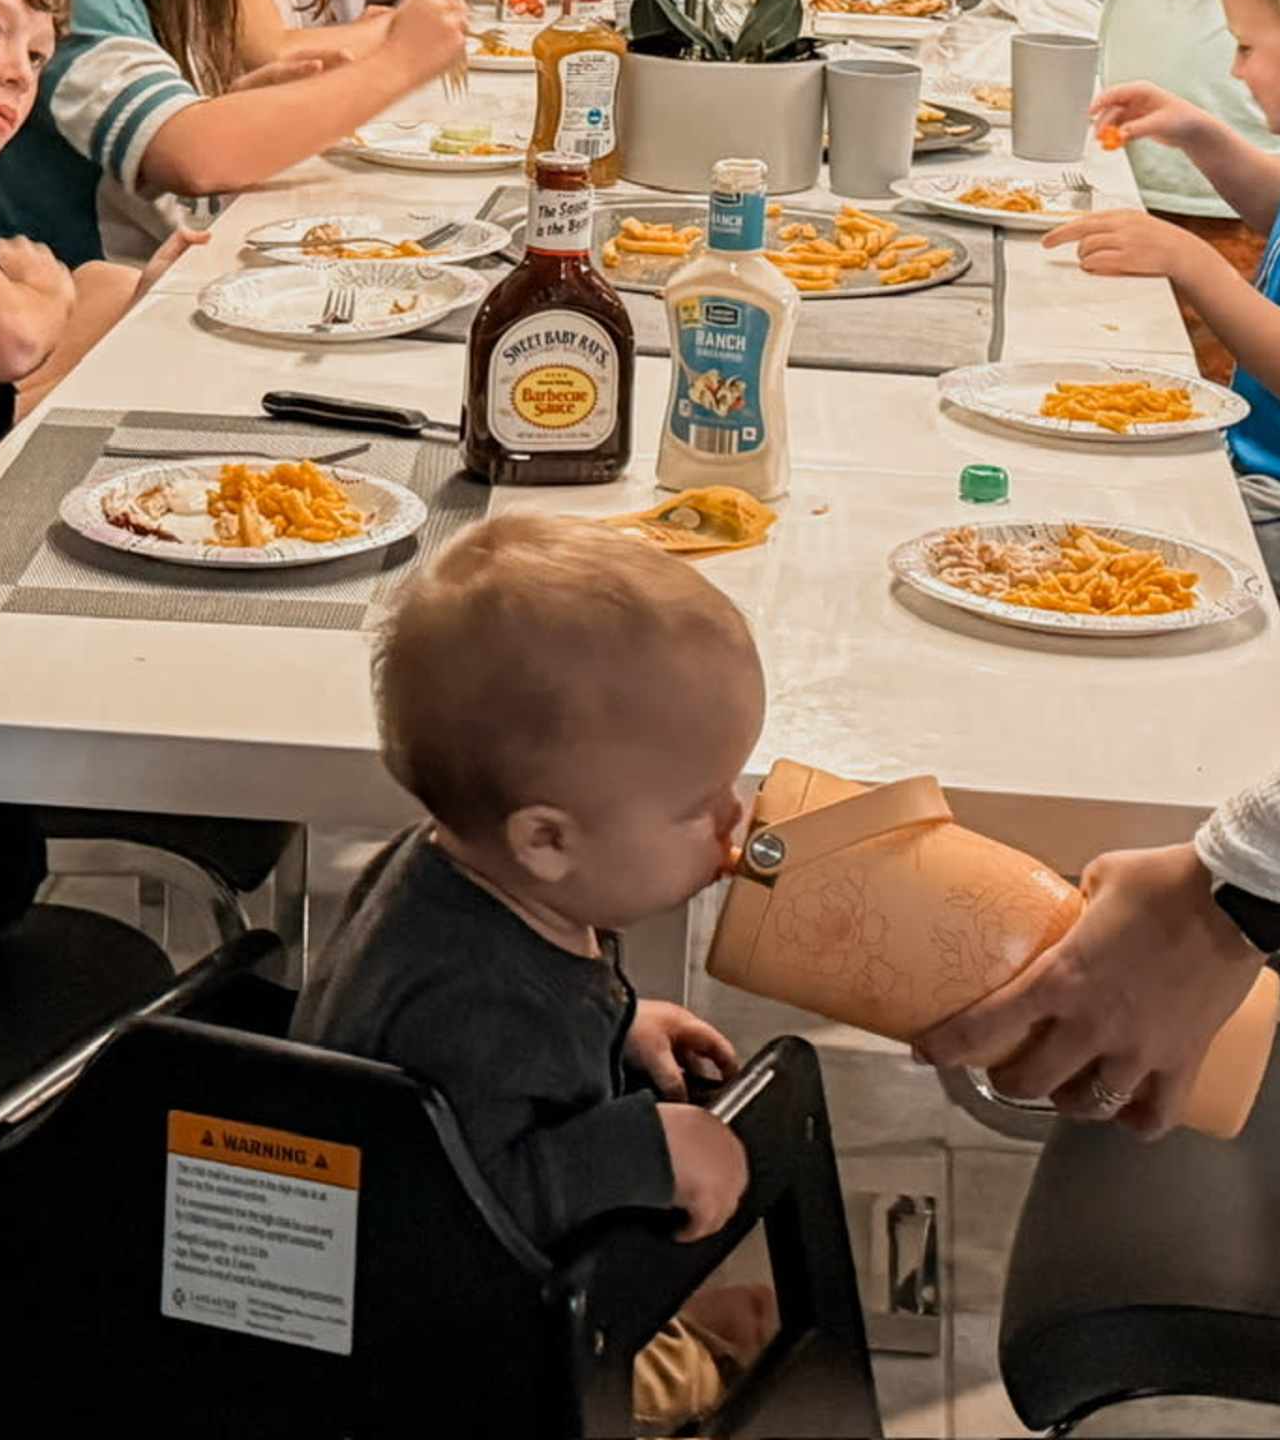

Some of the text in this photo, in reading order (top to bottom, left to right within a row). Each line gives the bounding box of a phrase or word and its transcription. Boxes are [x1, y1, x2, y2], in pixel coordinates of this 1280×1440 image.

[502, 331, 542, 366] SWEET
[543, 329, 579, 345] BABY
[695, 330, 747, 351] RANCH
[521, 387, 589, 403] Barbecue
[222, 1129, 308, 1166] WARNING
